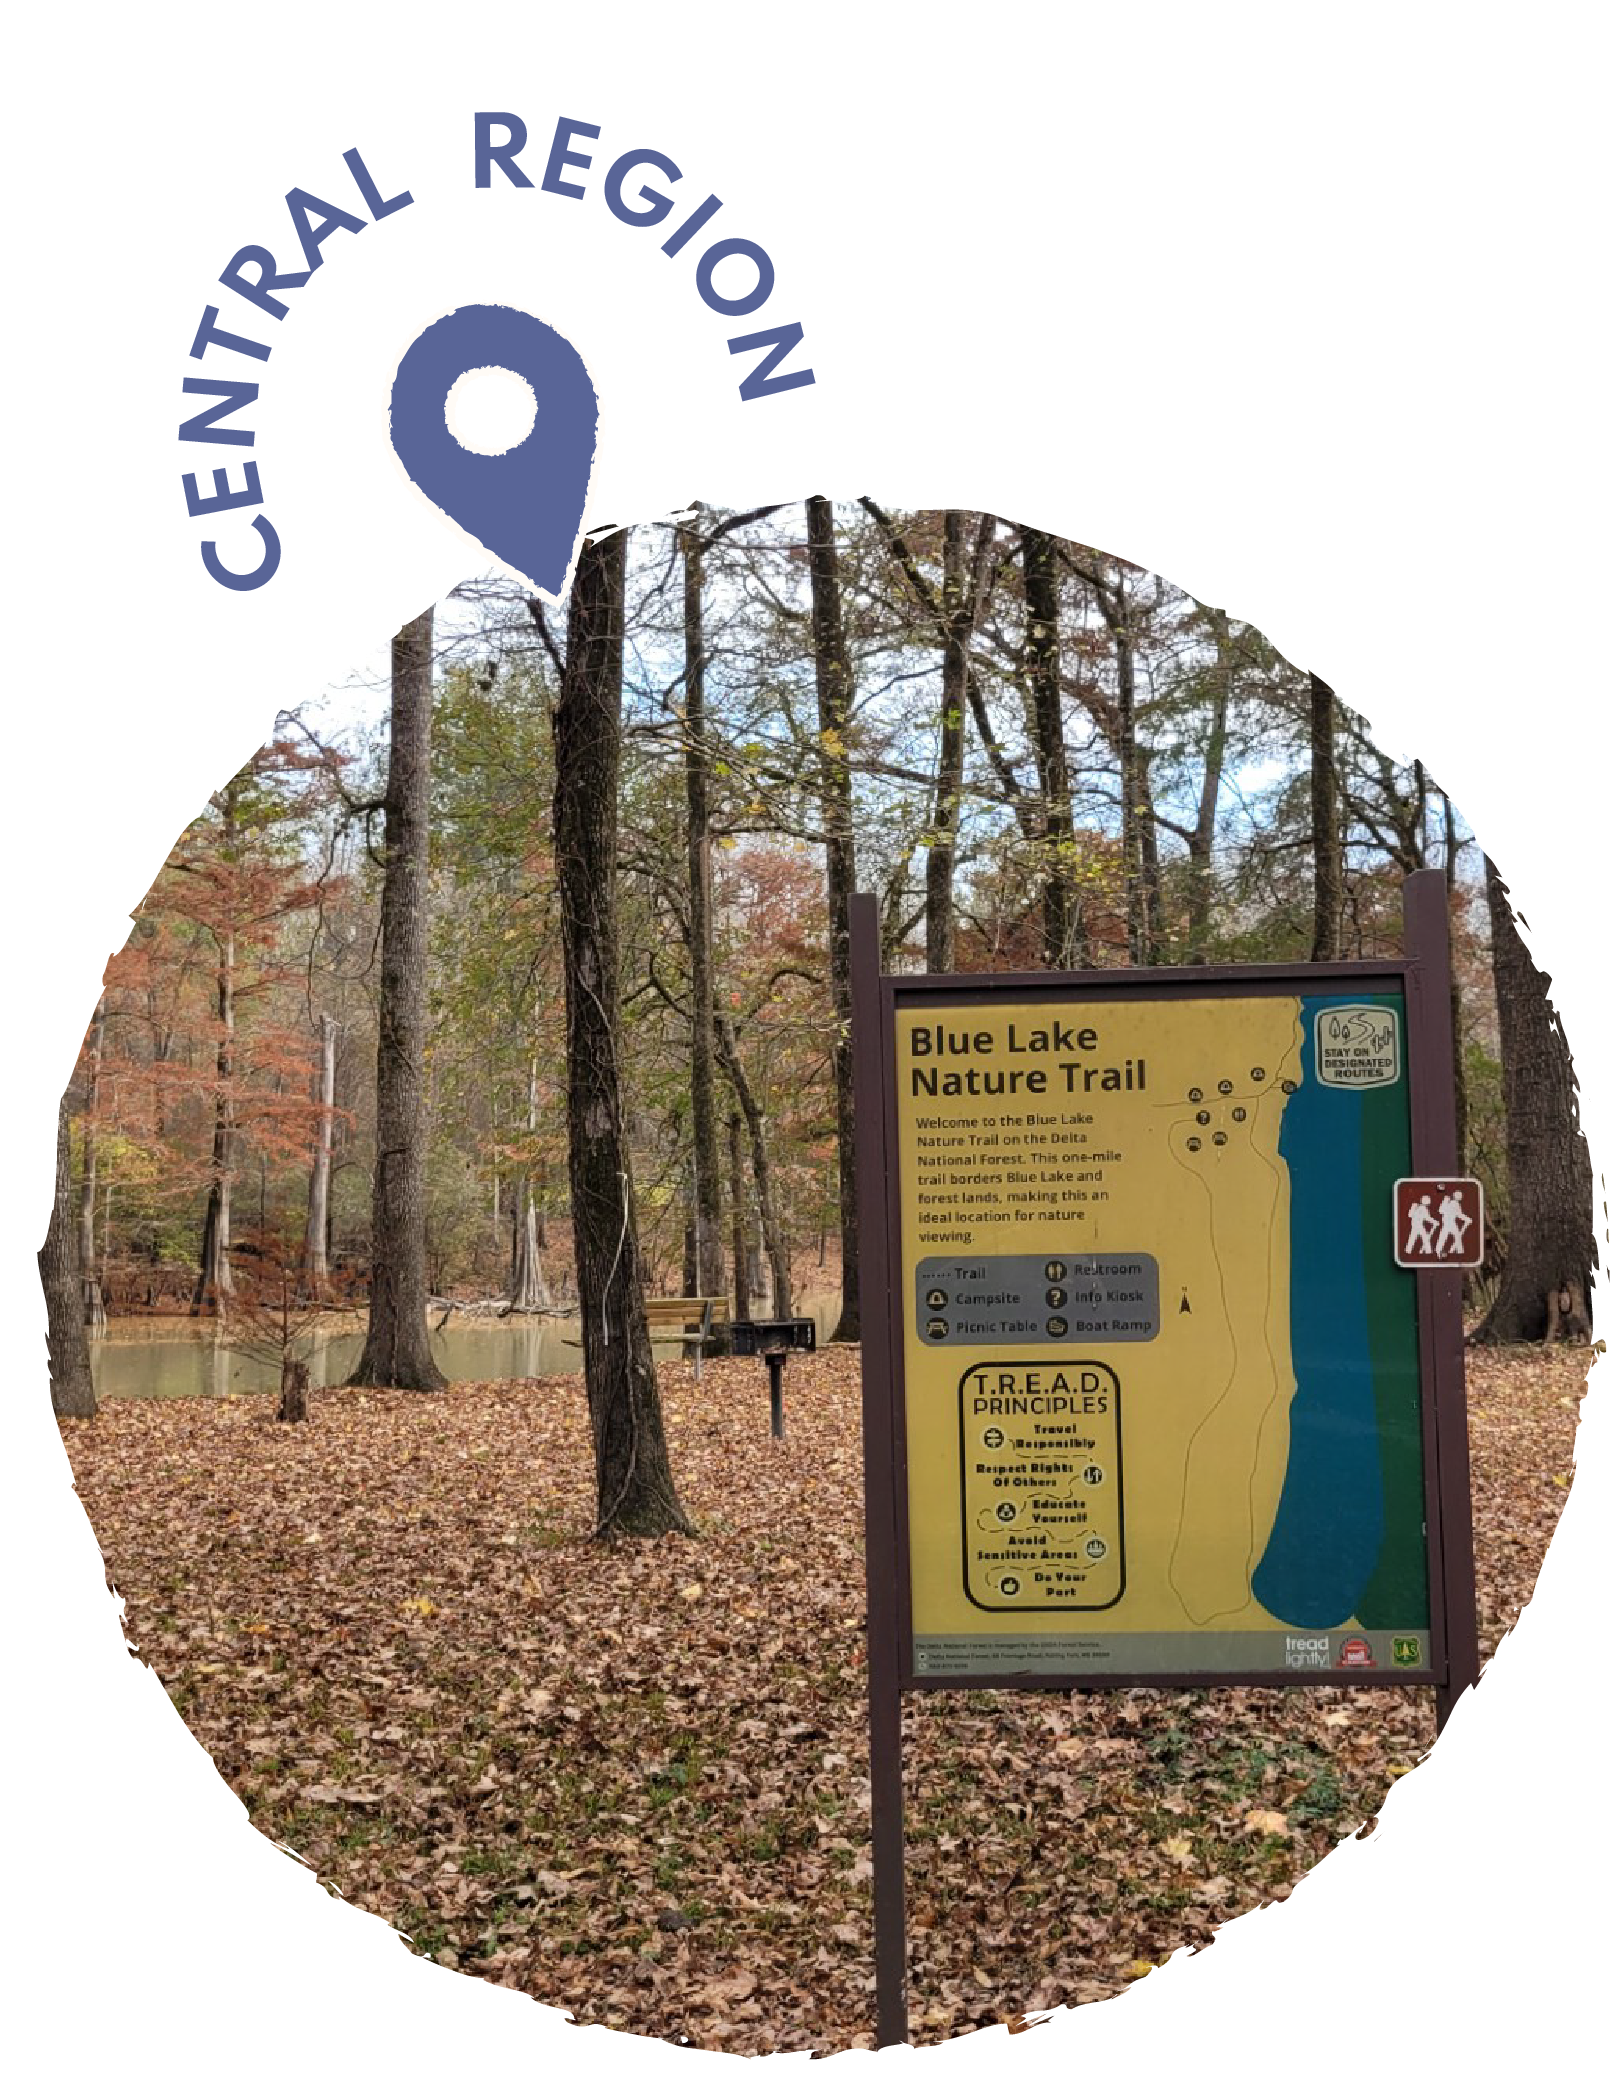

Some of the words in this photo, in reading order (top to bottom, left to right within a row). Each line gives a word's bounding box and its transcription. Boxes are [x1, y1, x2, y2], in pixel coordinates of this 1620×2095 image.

[911, 1024, 994, 1056] Blue
[1008, 1020, 1098, 1053] Lake
[1324, 1048, 1351, 1057] STAY
[1354, 1047, 1369, 1057] ON
[1324, 1058, 1393, 1068] DESIGNATED
[912, 1067, 1048, 1096] Nature
[1059, 1059, 1146, 1092] Trail
[1334, 1068, 1384, 1078] ROUTES
[916, 1117, 978, 1129] Welcome
[983, 1117, 996, 1127] to
[1000, 1115, 1023, 1127] the
[1026, 1114, 1057, 1126] Blue
[1061, 1113, 1094, 1125] Lake
[917, 1135, 965, 1147] Nature
[968, 1134, 999, 1146] Trail
[1003, 1135, 1021, 1146] on
[1023, 1132, 1047, 1145] the
[1051, 1132, 1088, 1144] Delta
[917, 1154, 976, 1166] National
[980, 1153, 1026, 1165] Forest.
[1031, 1152, 1058, 1164] This
[1062, 1150, 1122, 1163] one-mile
[918, 1173, 946, 1185] trail
[950, 1172, 1002, 1185] borders
[1007, 1171, 1037, 1183] Blue
[1040, 1170, 1074, 1183] Lake
[1077, 1169, 1103, 1182] and
[918, 1192, 959, 1204] forest
[962, 1191, 1002, 1205] lands,
[1007, 1190, 1058, 1204] making
[1062, 1189, 1088, 1202] this
[1091, 1190, 1109, 1201] an
[918, 1211, 952, 1224] ideal
[955, 1210, 1011, 1223] location
[1015, 1209, 1035, 1221] for
[1038, 1209, 1085, 1221] nature
[918, 1231, 975, 1244] viewing.
[954, 1267, 986, 1280] Trail
[1074, 1264, 1142, 1276] Restroom
[955, 1292, 1021, 1307] Campsite
[1076, 1291, 1102, 1304] Info
[1106, 1289, 1144, 1302] Kiosk
[956, 1321, 996, 1334] Picnic
[1000, 1320, 1038, 1333] Table
[1076, 1320, 1108, 1333] Boat
[1112, 1320, 1152, 1334] Ramp
[974, 1372, 1107, 1395] T.R.E.A.D.
[974, 1397, 1107, 1415] PRINCIPLES
[1034, 1423, 1077, 1434] Travel
[1015, 1438, 1096, 1450] Responsibly
[976, 1463, 1027, 1475] Respect
[1031, 1462, 1074, 1475] Rights
[993, 1477, 1010, 1487] Of
[1013, 1476, 1057, 1487] Others
[1032, 1499, 1086, 1509] Educate
[1032, 1512, 1088, 1523] Yourself
[1009, 1535, 1047, 1545] Avoid
[978, 1549, 1037, 1560] Sensitive
[1040, 1549, 1078, 1559] Areas
[1034, 1572, 1052, 1582] Do
[1056, 1572, 1087, 1582] Your
[1046, 1587, 1077, 1597] Part
[1286, 1635, 1329, 1651] tread
